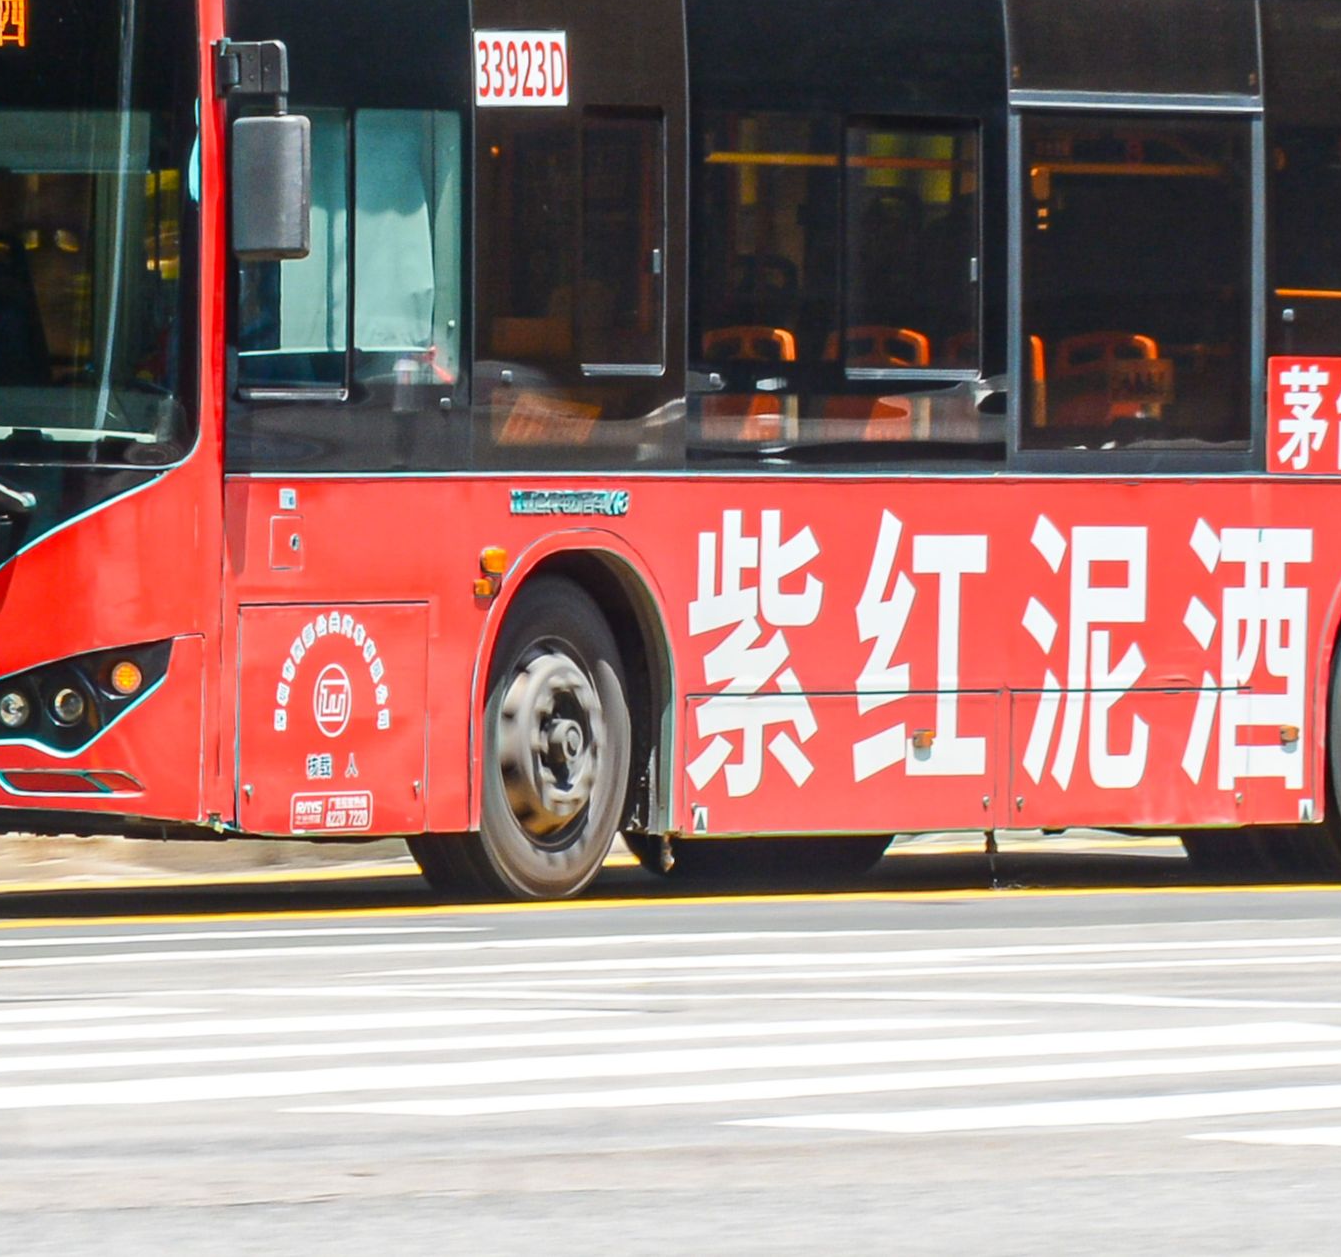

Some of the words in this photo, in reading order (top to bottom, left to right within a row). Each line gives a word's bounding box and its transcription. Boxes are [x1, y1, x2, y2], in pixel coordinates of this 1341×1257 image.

[478, 40, 565, 97] 33923D
[685, 509, 1313, 797] 紫红泥酒
